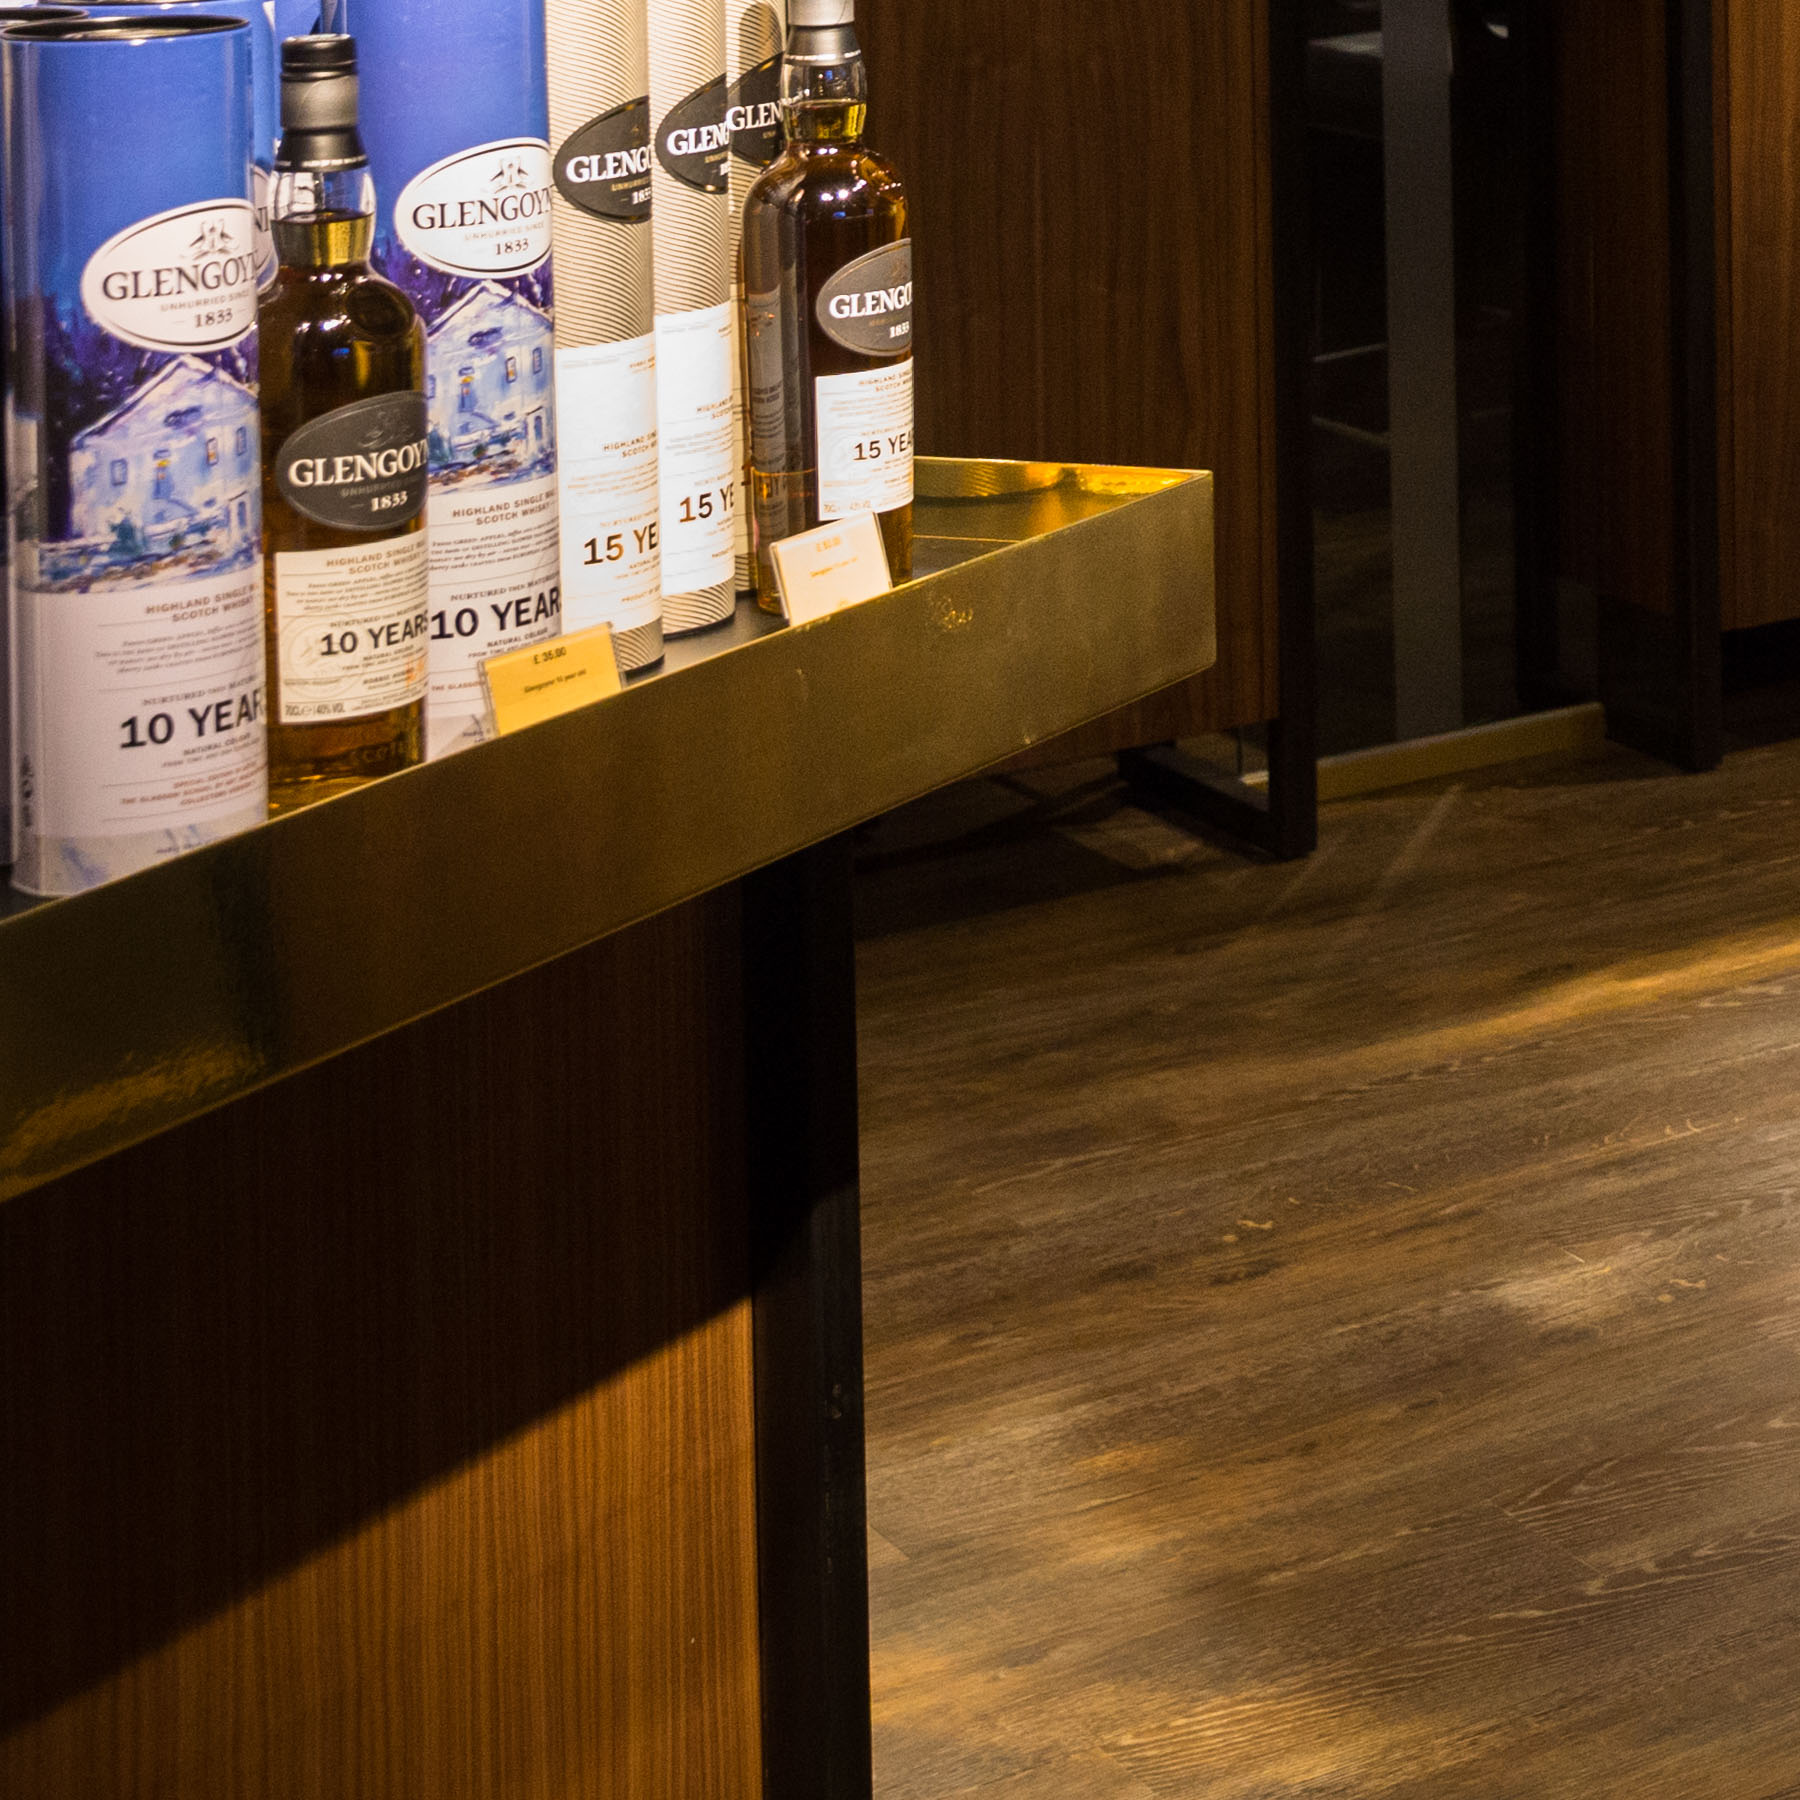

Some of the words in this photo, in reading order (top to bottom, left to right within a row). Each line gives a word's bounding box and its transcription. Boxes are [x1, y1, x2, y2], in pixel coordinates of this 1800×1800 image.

[495, 238, 530, 257] 1833
[193, 308, 234, 329] 1833
[889, 325, 910, 339] 1833
[604, 435, 645, 452] HIGHLAND
[854, 440, 882, 462] 15
[371, 491, 408, 512] 1833
[452, 501, 511, 519] HIGHLAND
[513, 495, 546, 509] SINGLE
[679, 492, 713, 524] 15
[475, 510, 518, 527] SCOTCH
[583, 533, 625, 566] 15
[326, 553, 383, 568] HIGHLAND
[349, 563, 391, 575] SCOTCH
[145, 596, 211, 615] HIGHLAND
[172, 606, 220, 622] SCOTCH
[430, 607, 479, 641] 10
[320, 631, 358, 657] 10
[120, 711, 175, 749] 10
